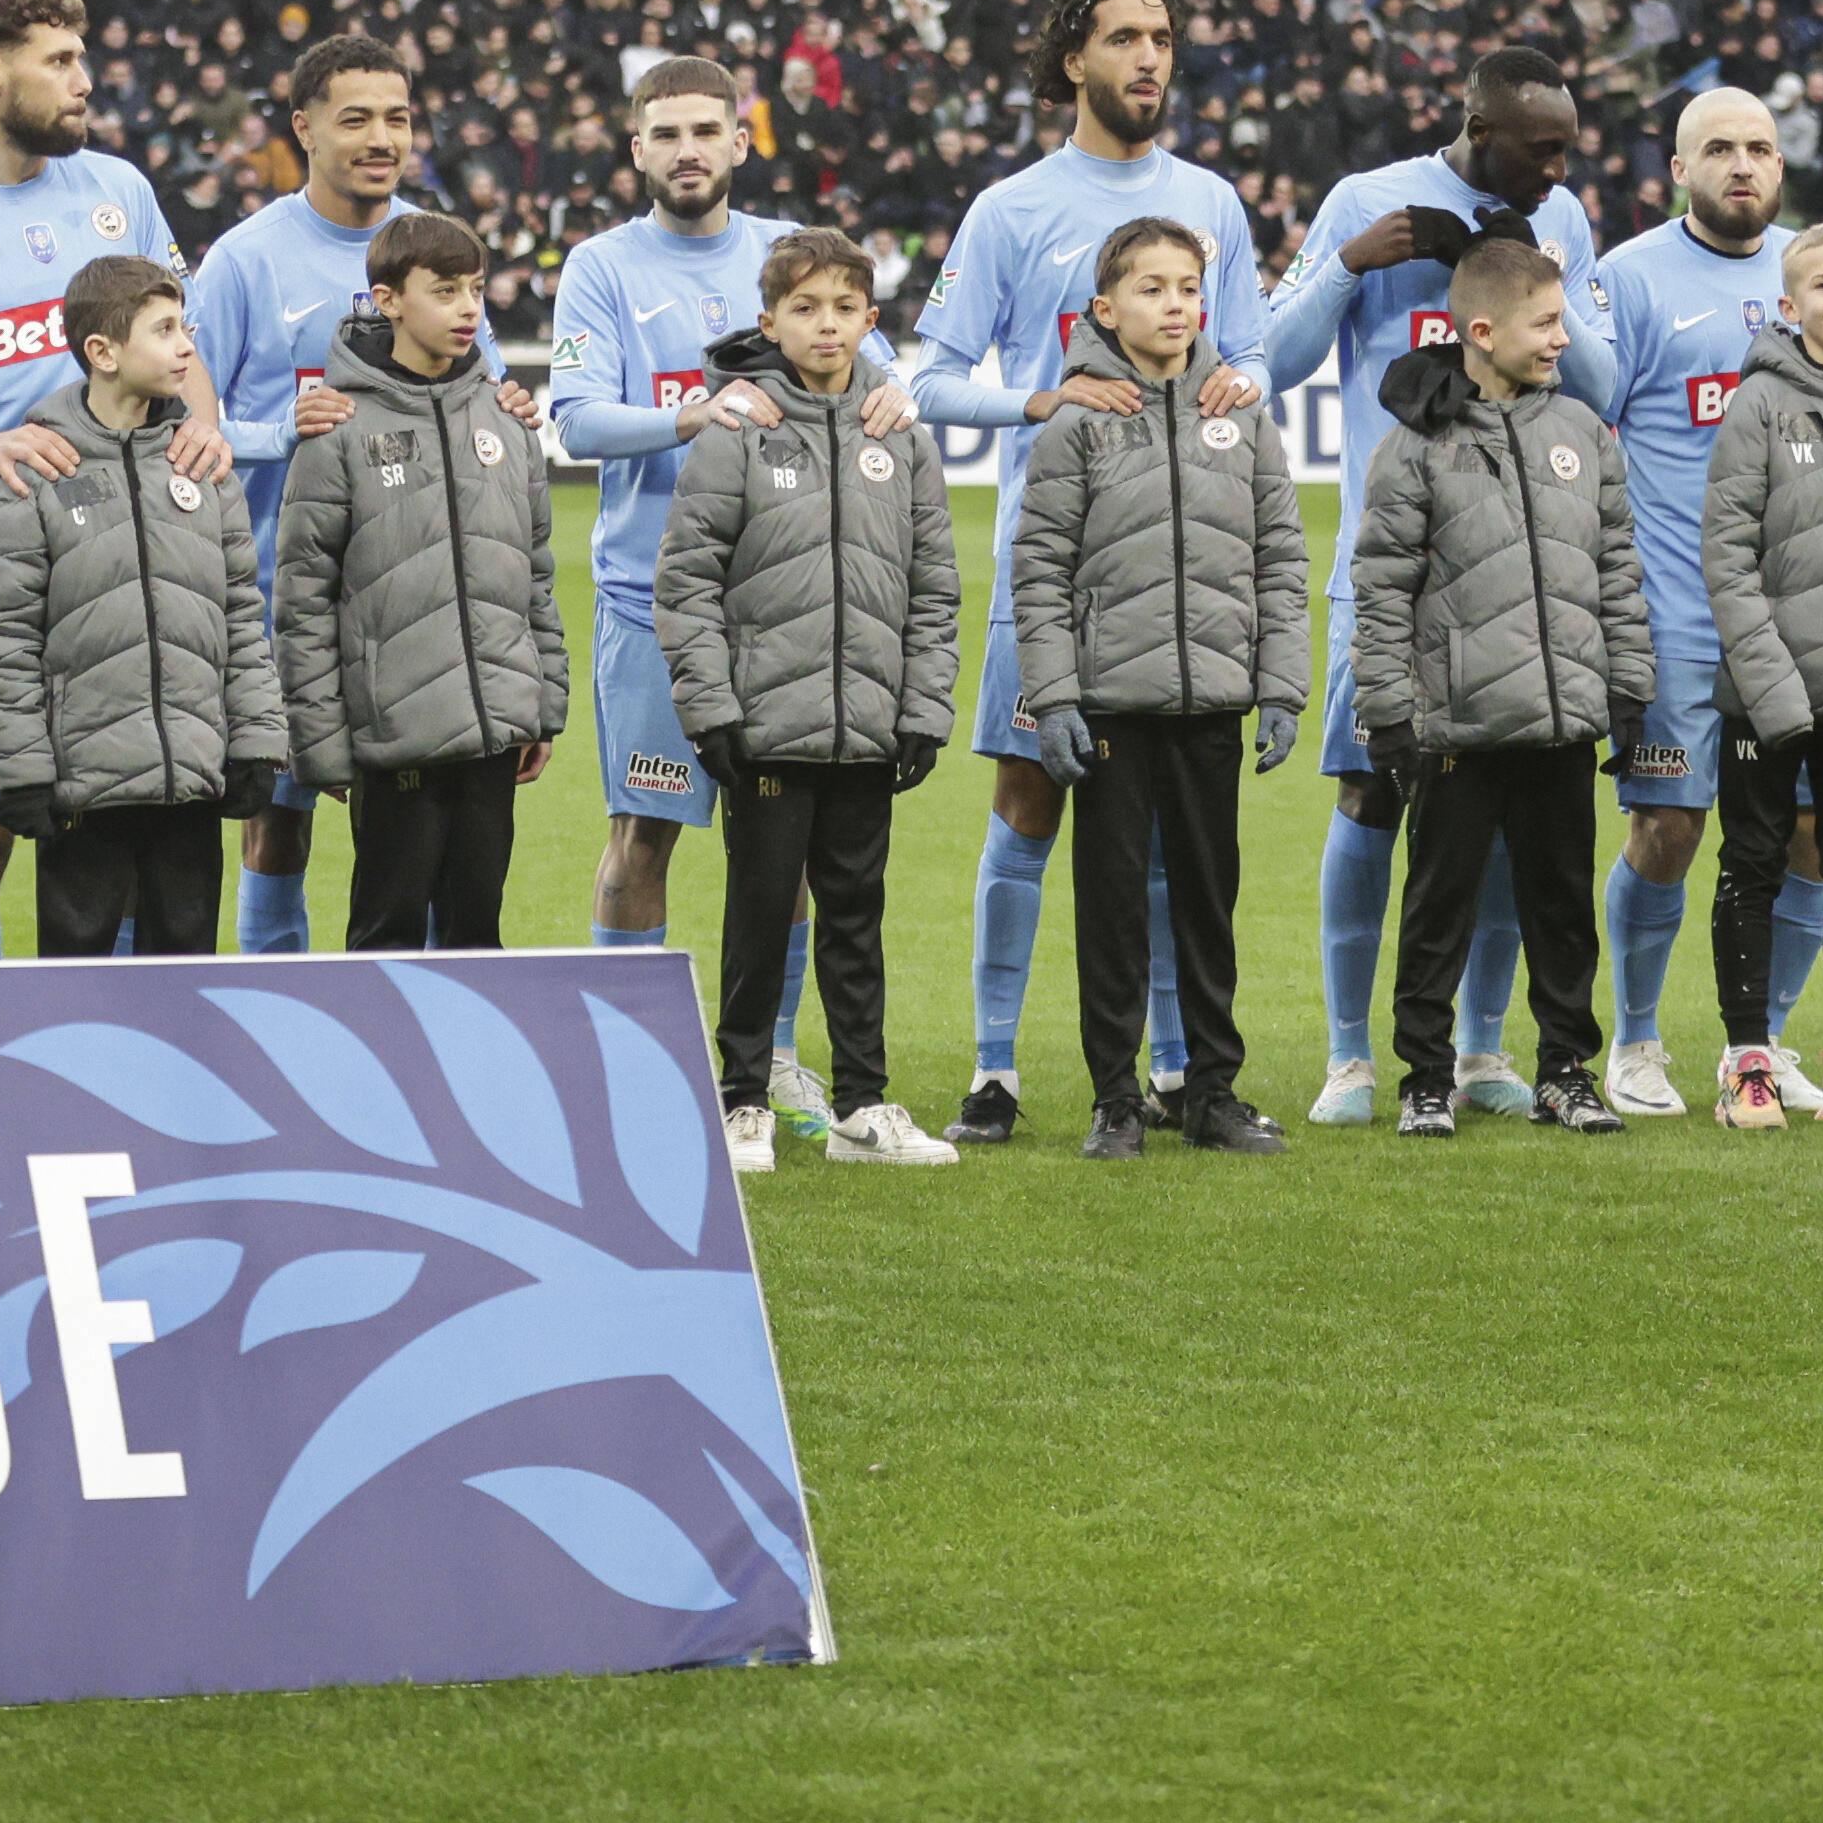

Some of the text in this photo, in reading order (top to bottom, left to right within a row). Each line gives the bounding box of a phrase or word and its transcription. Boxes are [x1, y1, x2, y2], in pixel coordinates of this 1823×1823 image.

[1791, 442, 1815, 464] VK
[381, 463, 405, 488] SR
[773, 467, 797, 488] RB
[1736, 739, 1759, 761] VK
